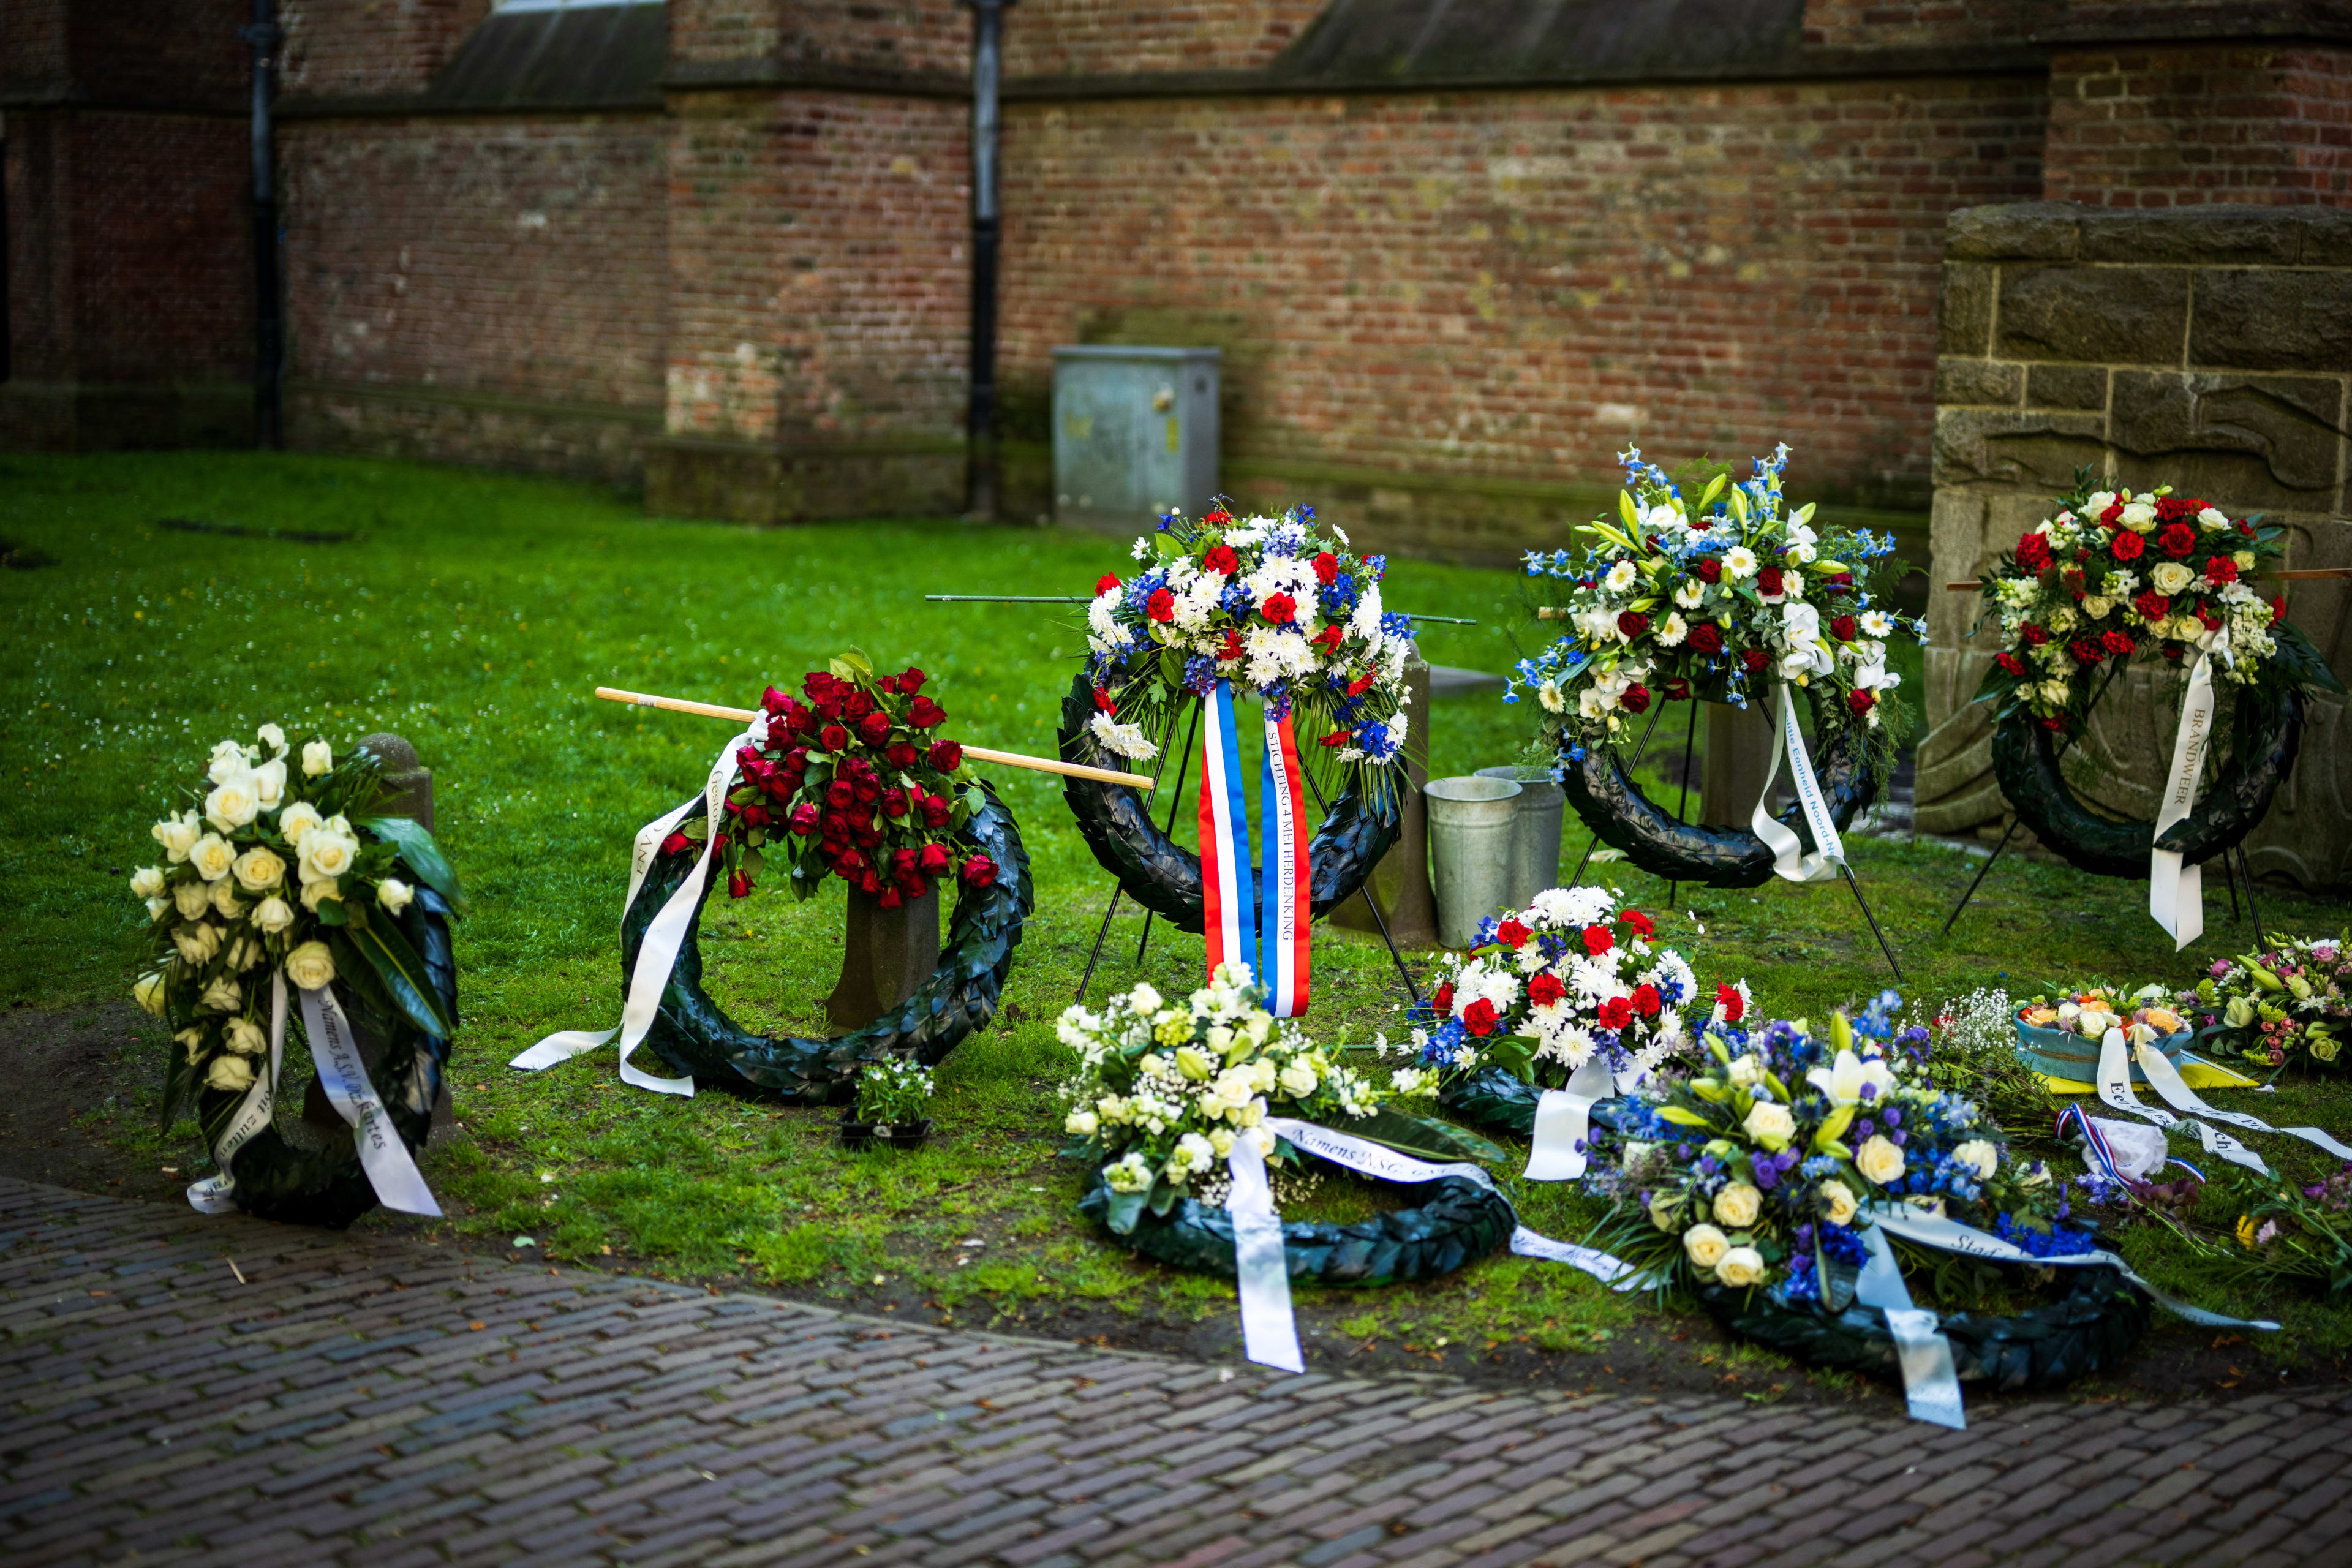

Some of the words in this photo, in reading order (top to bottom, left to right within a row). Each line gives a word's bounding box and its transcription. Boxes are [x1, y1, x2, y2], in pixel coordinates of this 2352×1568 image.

[1268, 732, 1291, 806] STICHTING
[1792, 748, 1814, 798] Eenheid
[2174, 708, 2206, 804] BRANDWEER
[636, 834, 653, 875] FNV
[1283, 820, 1293, 845] MEI
[1283, 850, 1294, 941] HERDENKING
[318, 998, 342, 1050] Namens
[219, 1112, 257, 1158] zullen
[1292, 1129, 1357, 1161] Namens
